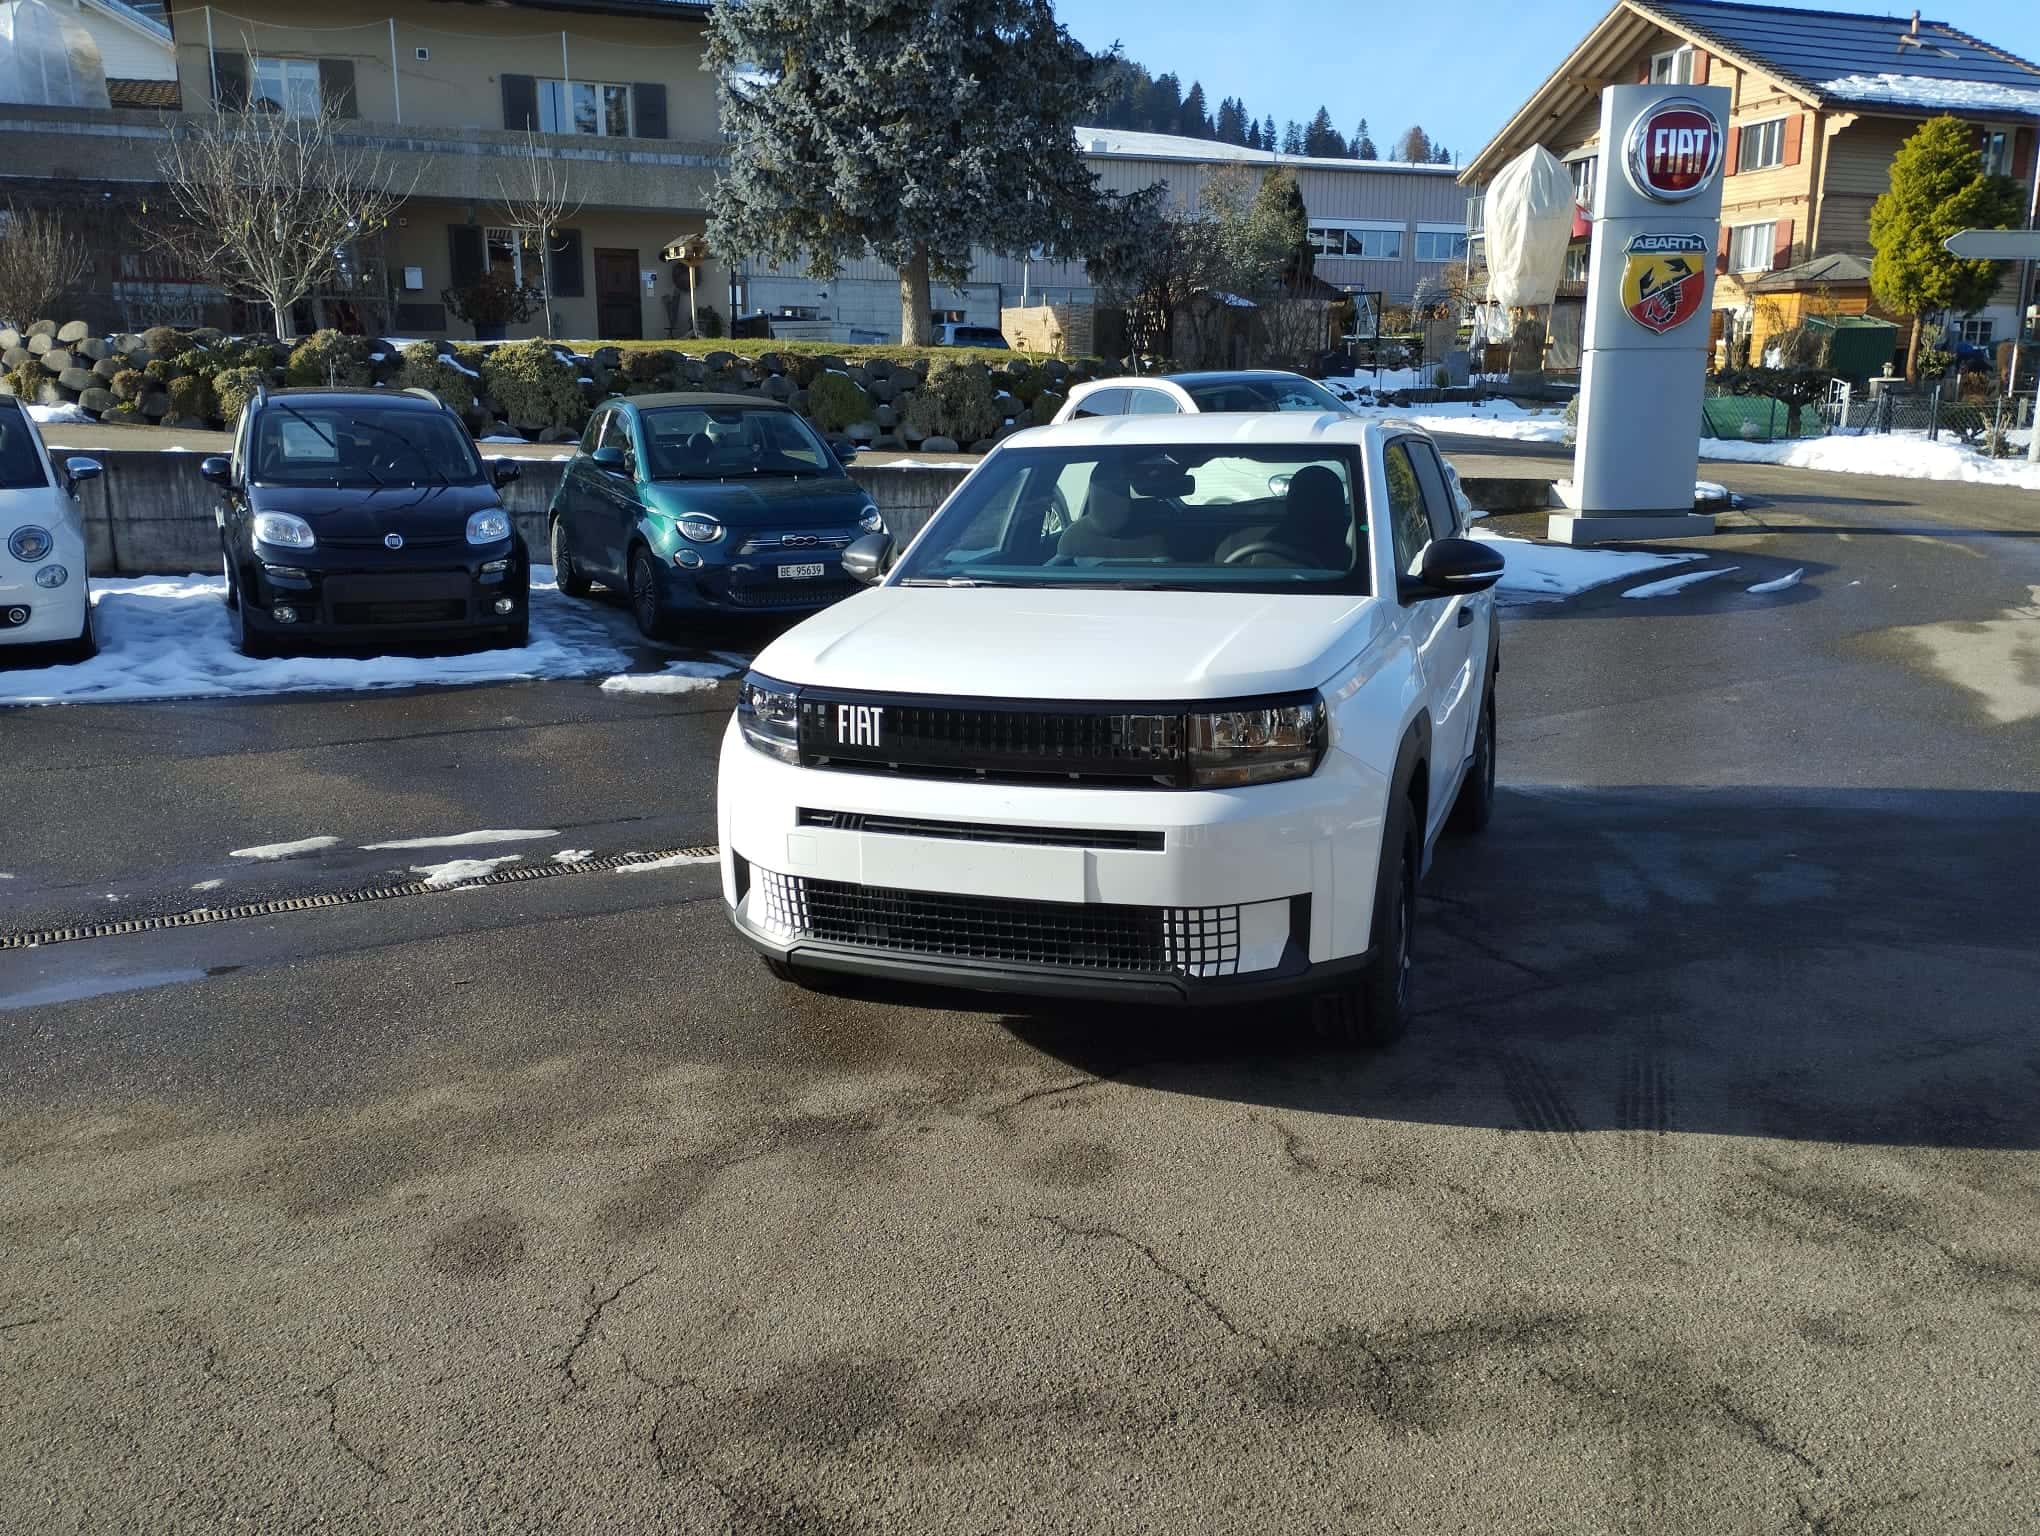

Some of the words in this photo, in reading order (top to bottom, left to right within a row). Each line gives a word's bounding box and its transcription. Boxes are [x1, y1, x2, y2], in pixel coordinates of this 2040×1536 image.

[1653, 128, 1708, 175] FIAT
[1633, 236, 1703, 249] ABARTH
[782, 534, 818, 547] 500
[780, 566, 793, 577] BE
[796, 564, 822, 576] 95639
[838, 704, 884, 747] FIAT
